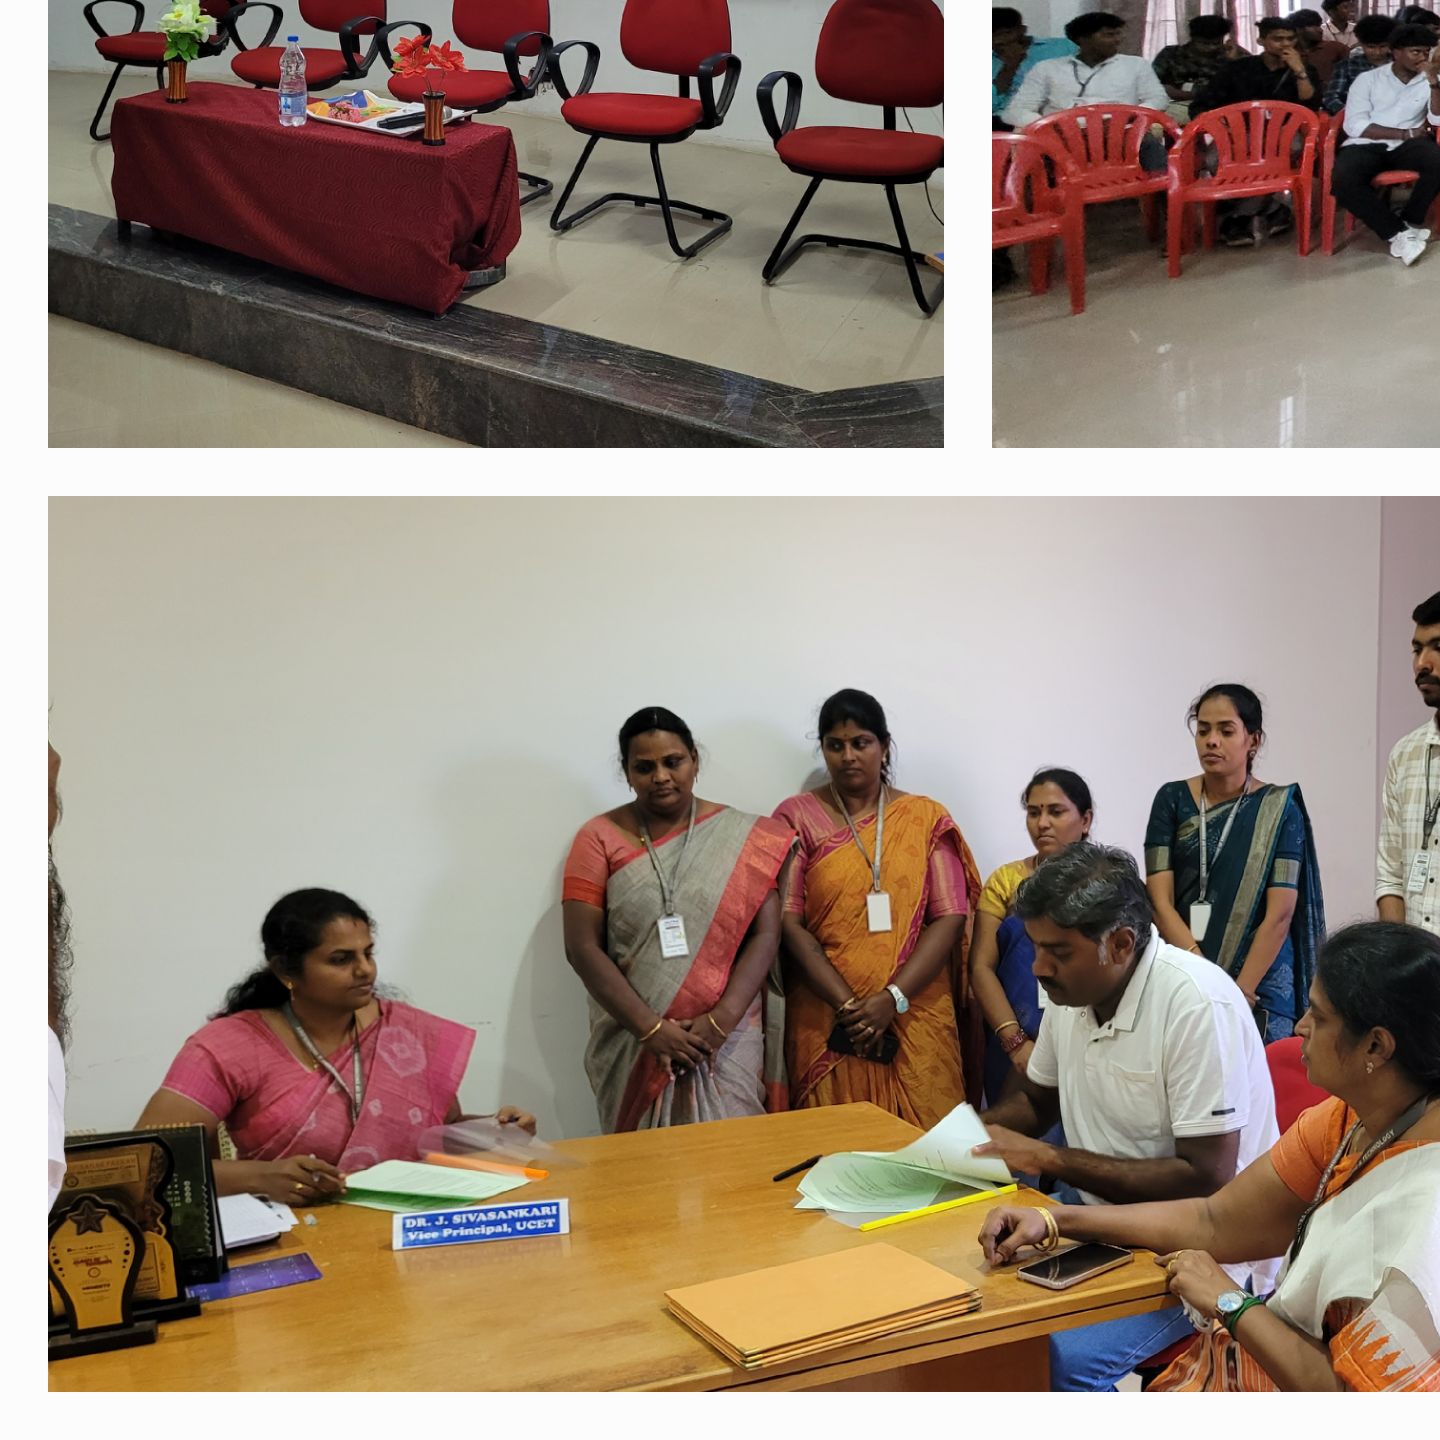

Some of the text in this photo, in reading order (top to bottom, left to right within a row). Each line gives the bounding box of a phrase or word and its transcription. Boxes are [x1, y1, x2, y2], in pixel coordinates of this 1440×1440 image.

[405, 1206, 557, 1228] DR. J. SIVASANKARI
[408, 1219, 556, 1240] Vice Principal, UCET
